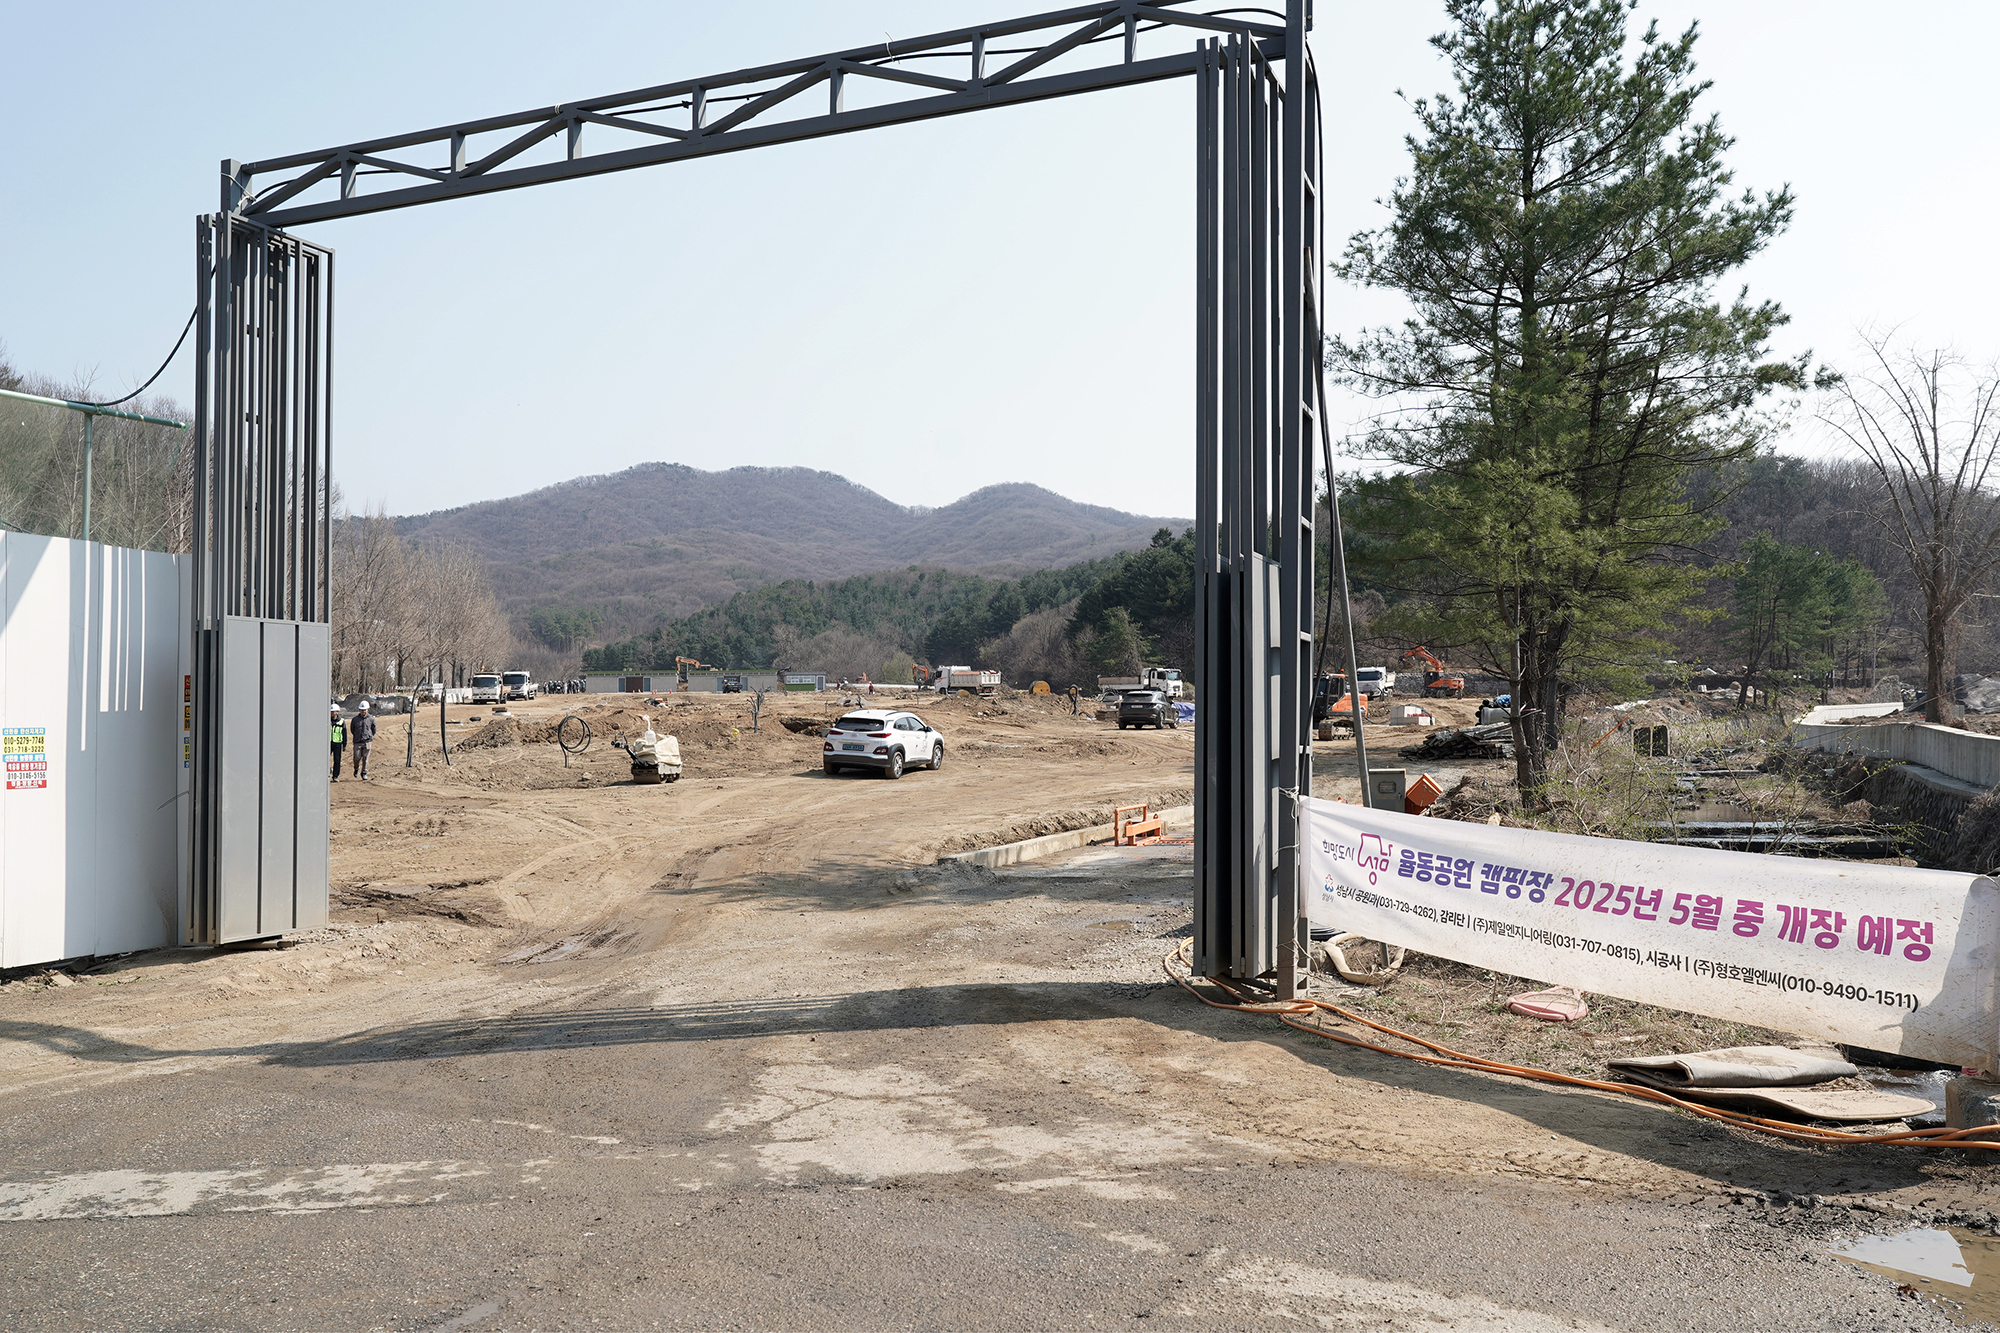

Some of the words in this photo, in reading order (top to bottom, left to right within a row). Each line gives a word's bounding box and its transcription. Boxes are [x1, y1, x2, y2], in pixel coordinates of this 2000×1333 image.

[1322, 839, 1355, 861] 희망도시
[1397, 848, 1475, 889] 율동공원
[1480, 862, 1554, 903] 캠핑장
[1554, 877, 1663, 921] 2025년
[1668, 892, 1723, 931] 5월
[1732, 899, 1764, 937] 중
[1776, 904, 1847, 949] 개장
[1857, 915, 1934, 962] 예정
[1336, 884, 1356, 899] 성남시
[1355, 889, 1439, 923] 공원과(031-729-4262),
[1440, 910, 1465, 928] 감리단
[1472, 917, 1644, 966] (주)제일엔지니어링(031-707-0815),
[1646, 950, 1681, 971] 시공사
[1693, 959, 1919, 1013] (주)형호엘엔씨(010-9490-1511)
